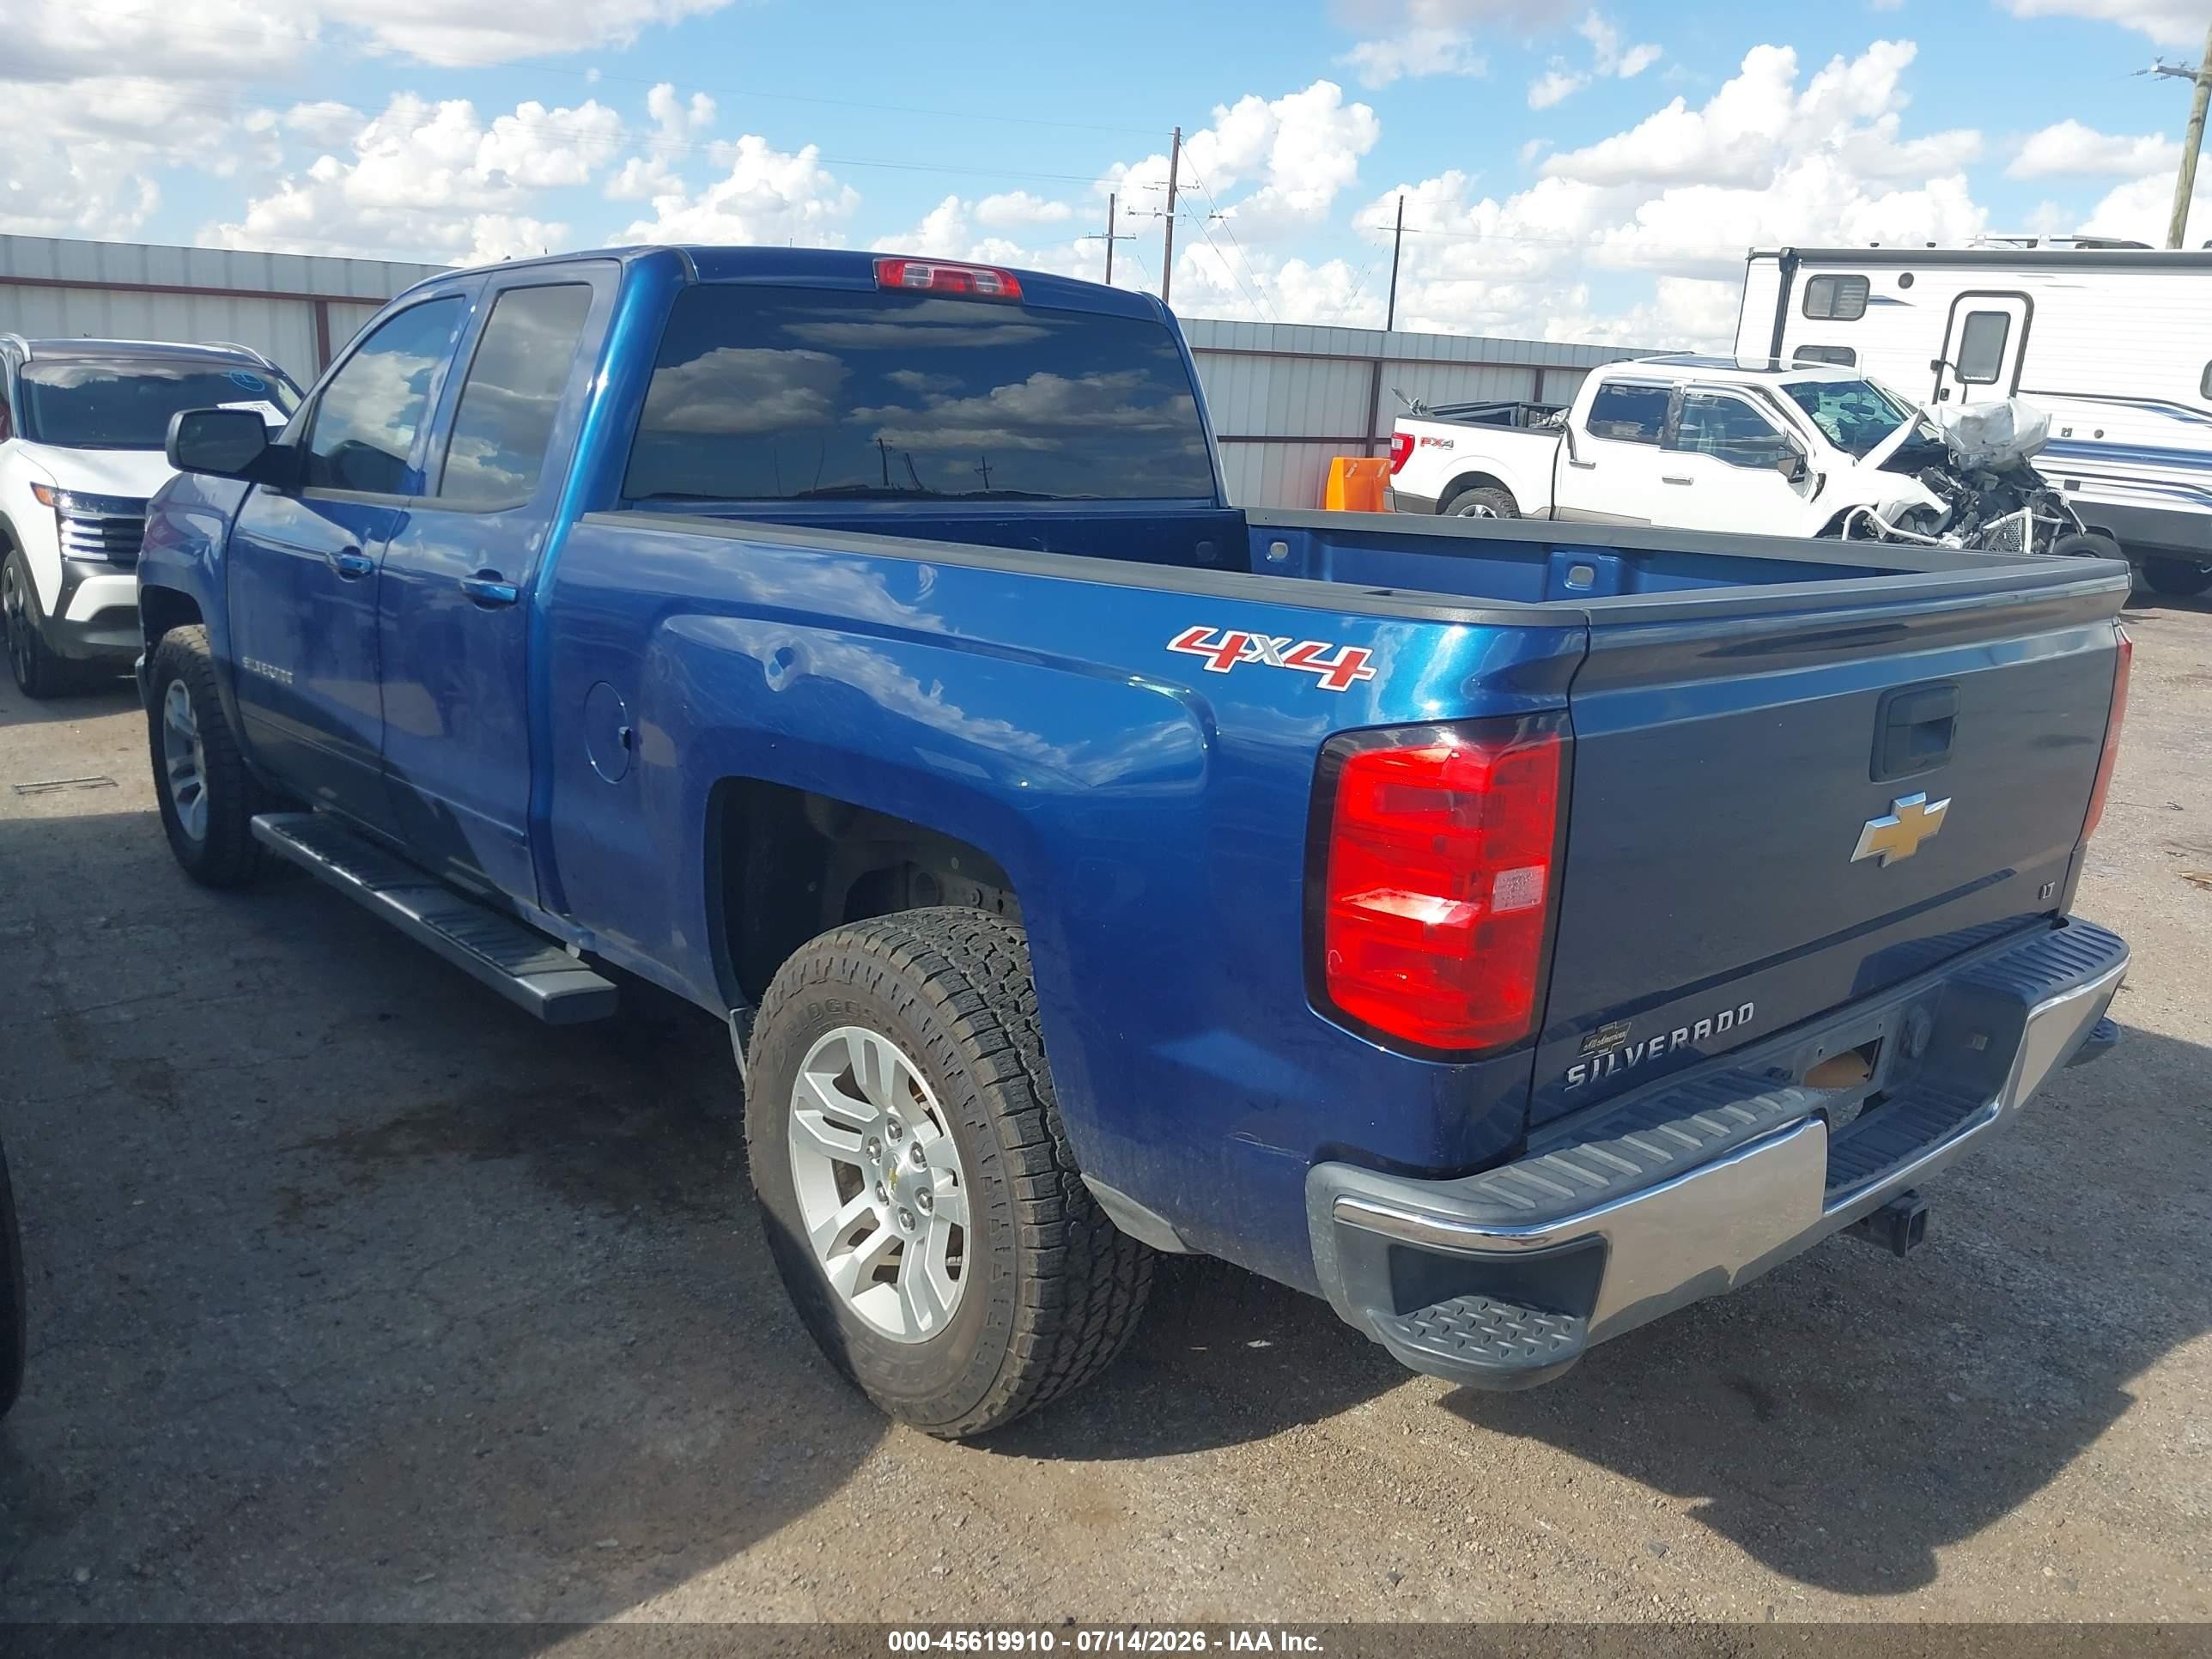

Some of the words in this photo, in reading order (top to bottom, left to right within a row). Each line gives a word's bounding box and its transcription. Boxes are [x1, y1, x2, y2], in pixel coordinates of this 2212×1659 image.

[1420, 436, 1455, 447] FX4
[2042, 881, 2056, 899] LT
[1564, 1001, 1754, 1092] SILVERADO
